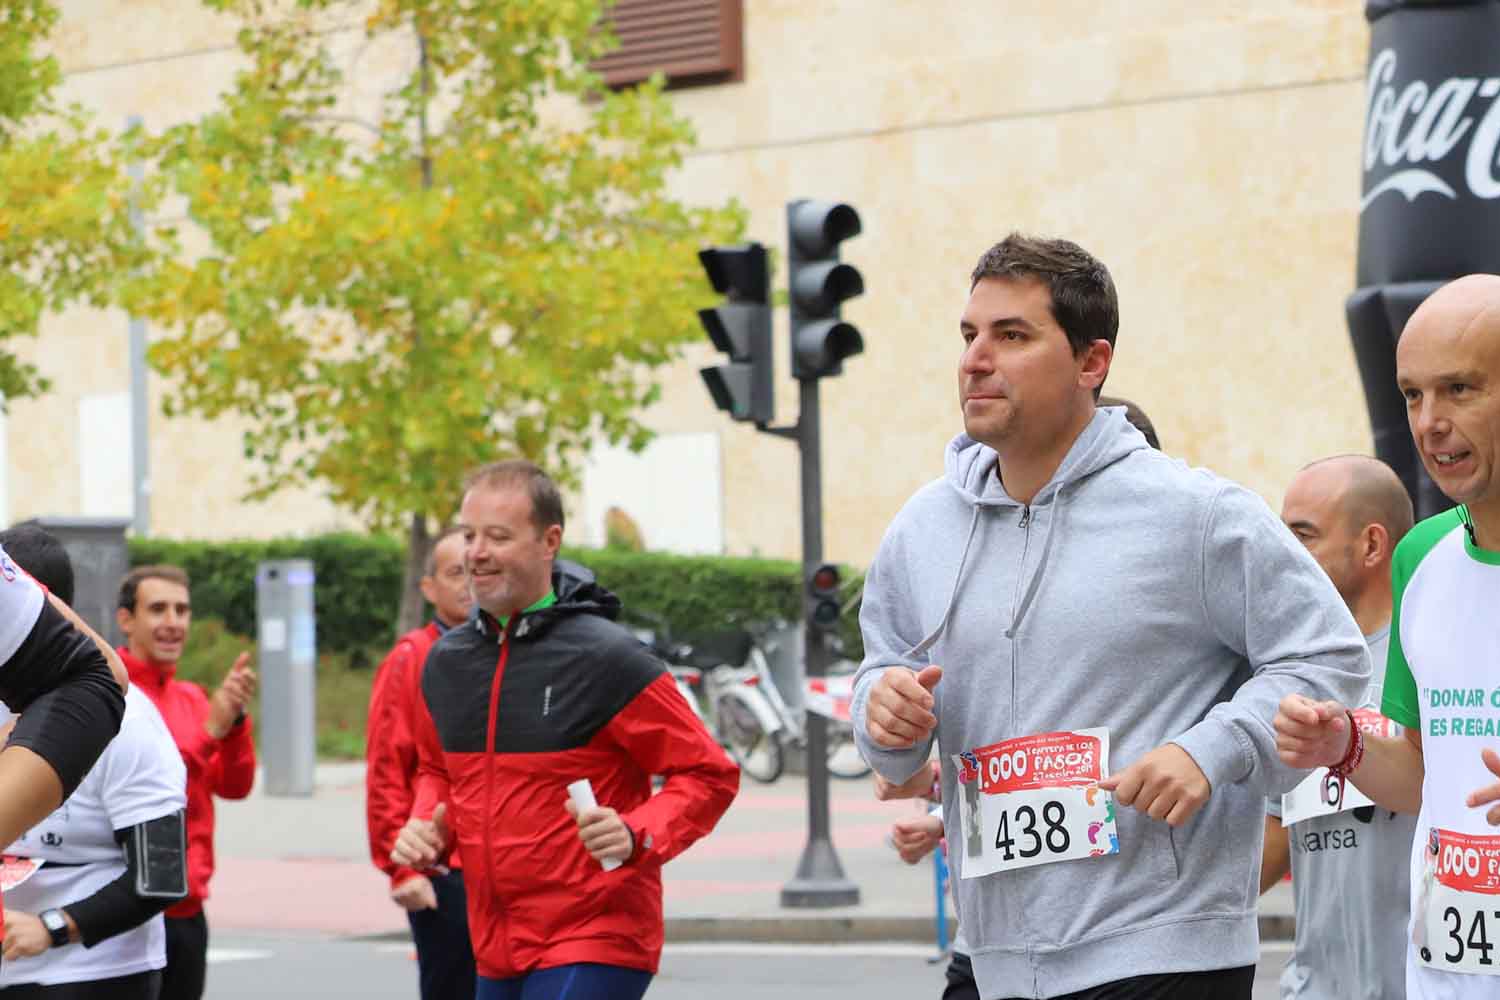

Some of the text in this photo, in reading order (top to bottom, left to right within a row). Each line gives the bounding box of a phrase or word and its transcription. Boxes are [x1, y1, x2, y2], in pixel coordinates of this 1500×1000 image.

[1430, 718, 1447, 736] ES
[1034, 751, 1094, 770] PASOS
[995, 800, 1070, 861] 438
[1303, 827, 1358, 853] arsa
